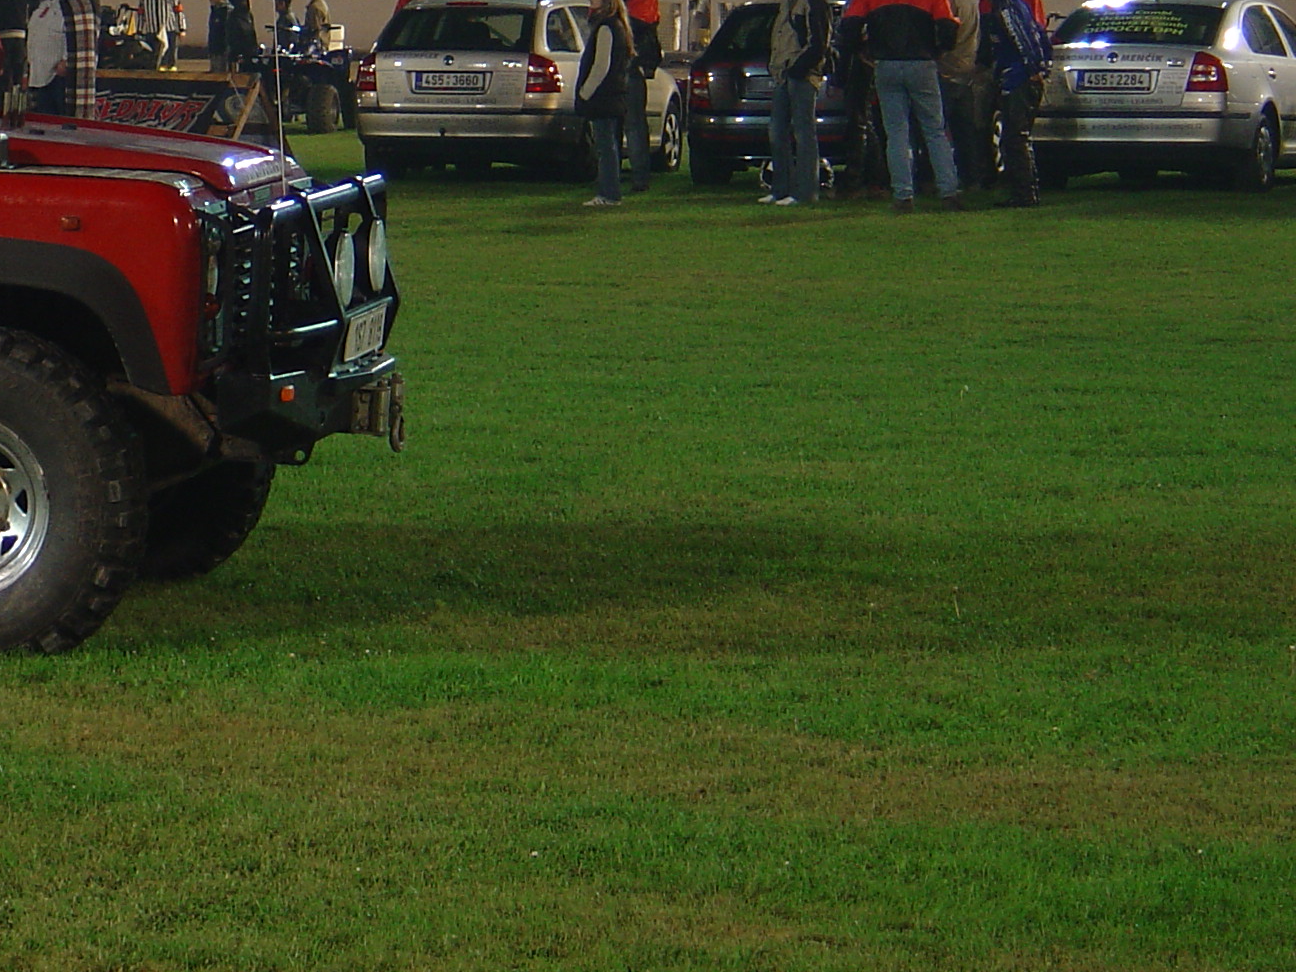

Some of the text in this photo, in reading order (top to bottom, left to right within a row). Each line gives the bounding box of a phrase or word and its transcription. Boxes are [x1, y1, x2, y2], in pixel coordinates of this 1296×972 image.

[424, 75, 479, 86] 4S5 3660
[1087, 74, 1144, 86] 4S5 2284
[94, 96, 208, 130] REDATOR
